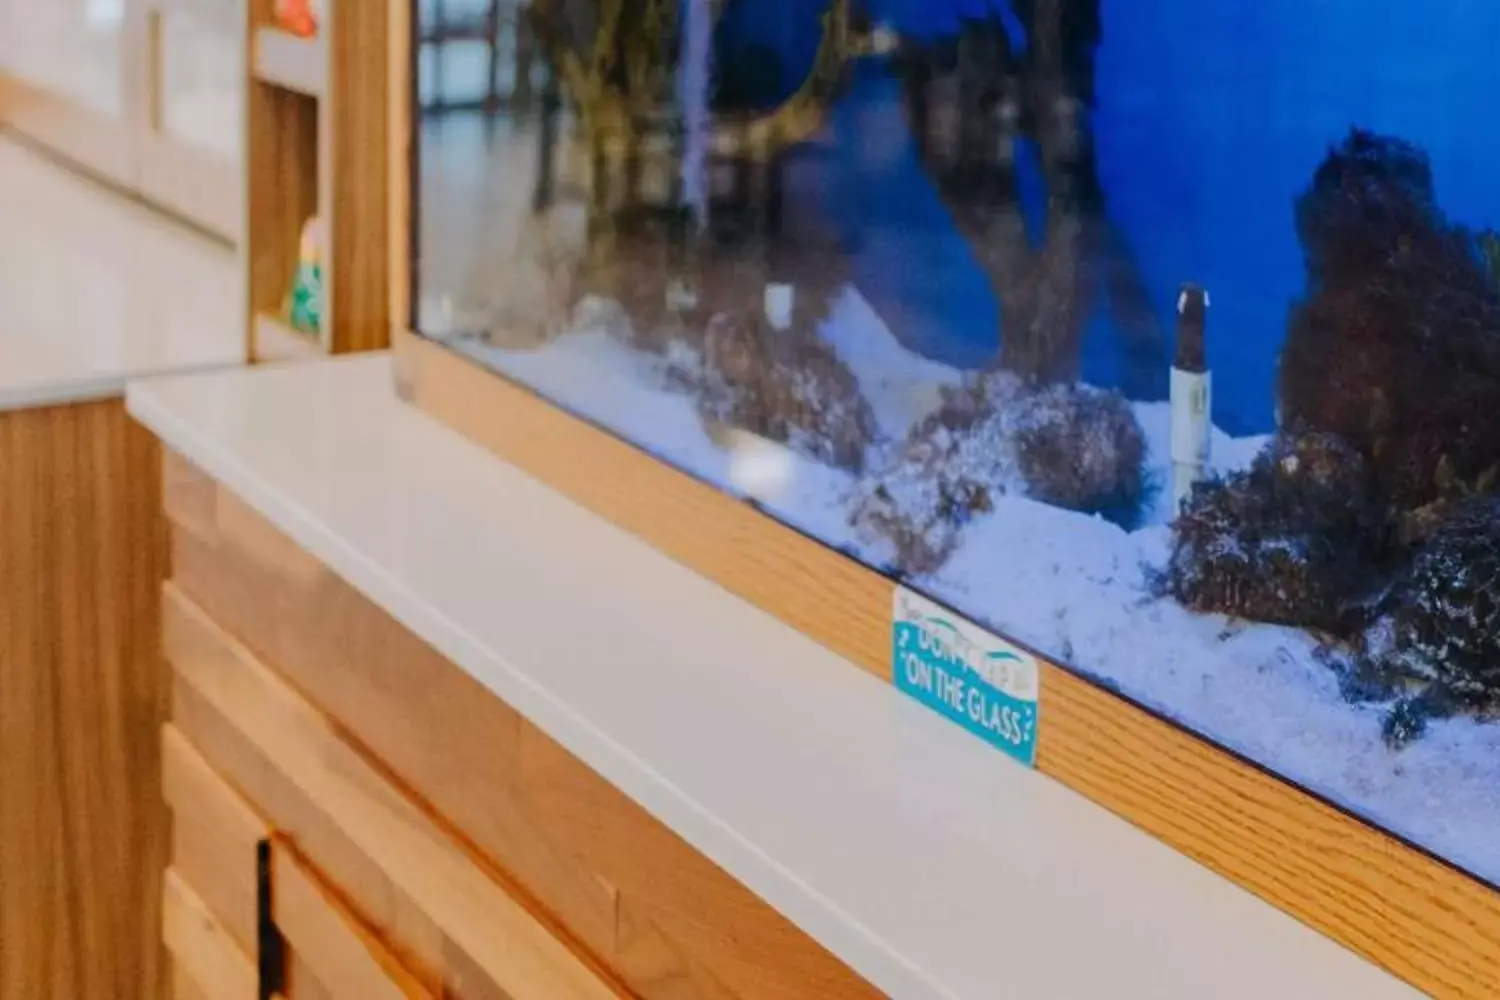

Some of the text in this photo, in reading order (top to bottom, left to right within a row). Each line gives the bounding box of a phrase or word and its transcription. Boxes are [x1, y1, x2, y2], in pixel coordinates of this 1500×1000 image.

[906, 652, 1021, 745] ON THE GLASS
